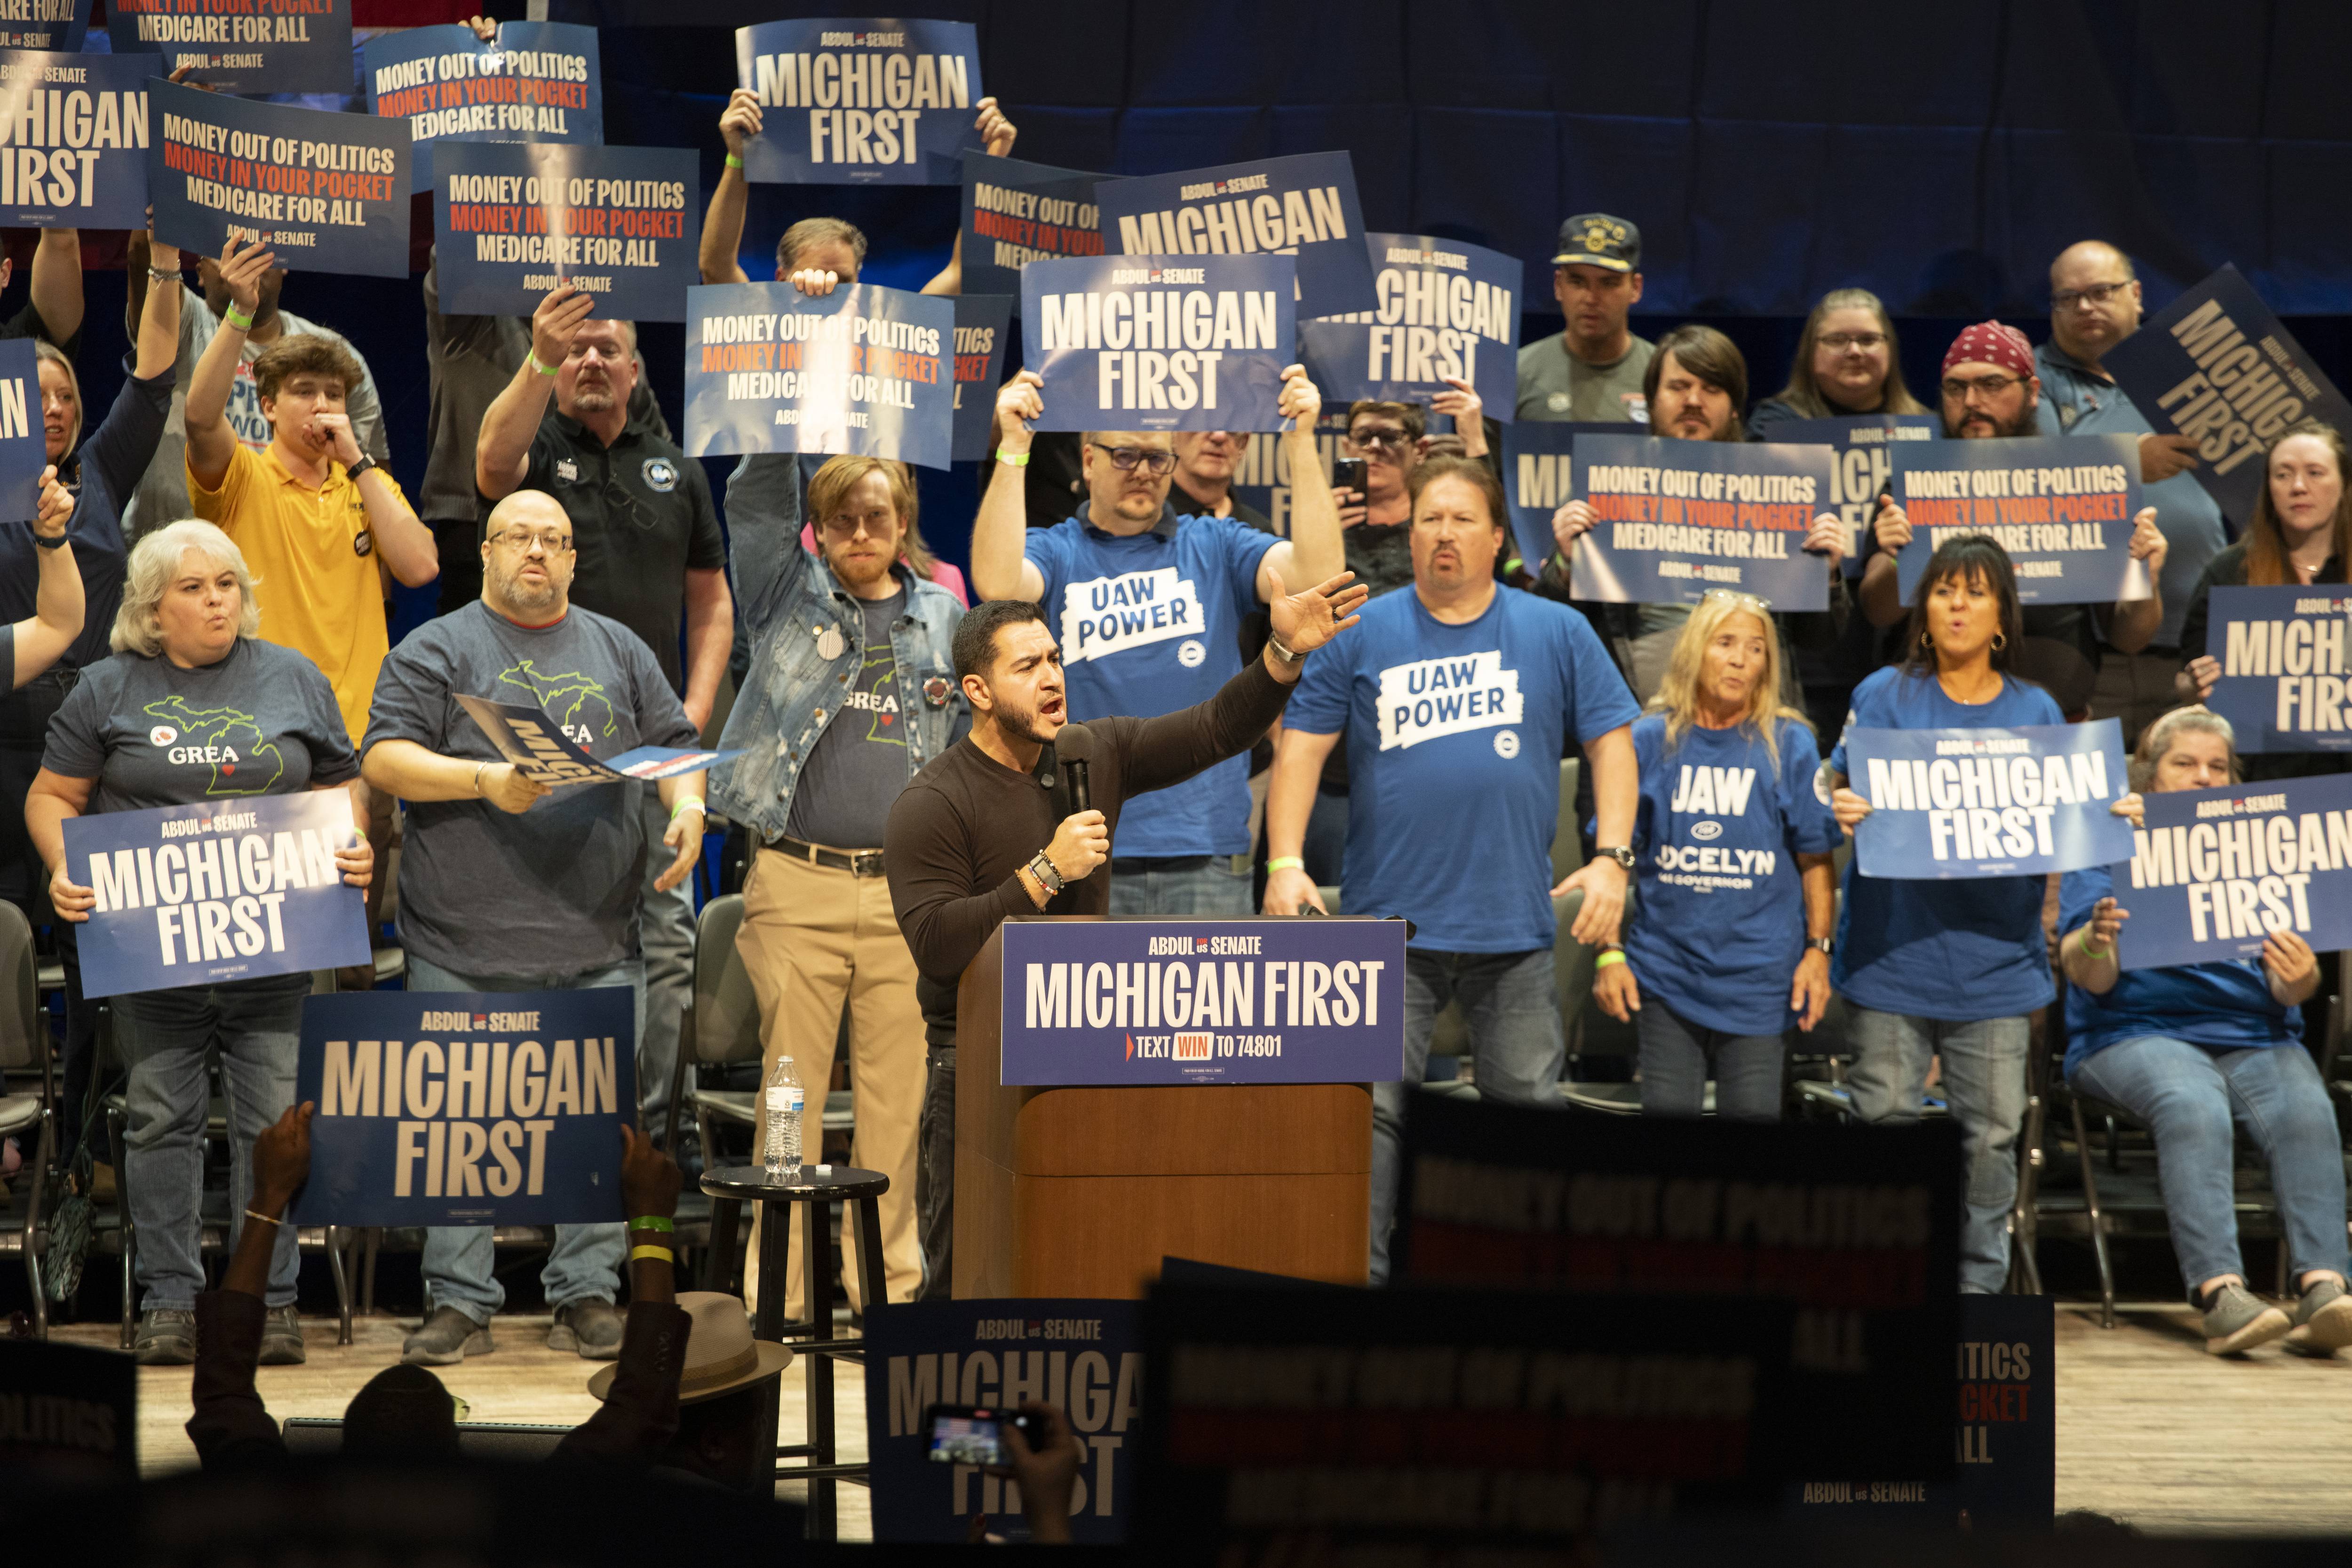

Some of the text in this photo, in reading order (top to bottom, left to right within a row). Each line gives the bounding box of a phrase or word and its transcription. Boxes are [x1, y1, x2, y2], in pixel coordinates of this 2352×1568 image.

[24, 33, 51, 48] SENATE
[138, 15, 310, 43] MEDICARE FOR ALL
[821, 32, 905, 48] ABDUL SENATE
[45, 67, 87, 83] SENATE
[176, 53, 263, 69] ABDUL SENATE
[376, 56, 436, 95] MONEY
[438, 52, 477, 81] OUT
[506, 50, 588, 82] POLITICS
[378, 77, 588, 118] MONEY IN YOUR POCKET
[756, 52, 969, 110] MICHIGAN
[498, 104, 568, 135] FOR ALL
[810, 110, 921, 165] FIRST
[164, 112, 395, 174] MONEY OUT OF POLITICS
[0, 148, 100, 208] IRST
[164, 141, 395, 201] MONEY IN YOUR POCKET
[1180, 174, 1269, 201] ABDUL SENATE
[187, 175, 366, 226] MEDICARE FOR ALL
[449, 175, 685, 210] MONEY OUT OF POLITICS
[975, 182, 1039, 220] MONEY
[1039, 197, 1077, 227] OUT
[273, 231, 317, 247] SENATE
[450, 204, 685, 239] MONEY IN POCKET
[974, 209, 1058, 252] MONEY IN
[1119, 186, 1347, 255] MICHIGAN
[477, 234, 660, 267] MEDICARE FOR ALL
[523, 274, 612, 293] ABDUL SENATE
[1112, 268, 1205, 285] ABDUL SENATE
[702, 313, 940, 356] MONEY OUT POLITICS
[1041, 291, 1277, 350] MICHIGAN
[702, 343, 777, 373] MONEY
[779, 343, 803, 370] IN
[866, 347, 939, 385] POCKET
[1368, 326, 1479, 387] FIRST
[881, 378, 915, 410] ALL
[1098, 350, 1222, 410] FIRST
[2156, 370, 2266, 476] FIRST
[1588, 465, 1661, 495] MONEY
[1661, 469, 1700, 498] OUT
[1700, 471, 1725, 501] OF
[1725, 475, 1817, 504] POLITICS
[1904, 470, 1971, 498] MONEY
[1971, 470, 2010, 497] OUT
[2011, 468, 2038, 497] OF
[2037, 465, 2128, 495] POLITICS
[1588, 494, 1816, 532] MONEY IN YOUR POCKET
[1906, 493, 2127, 526] MONEY IN YOUR POCKET
[1613, 521, 1788, 560] MEDICARE FOR ALL
[2031, 524, 2071, 552] FOR
[2071, 522, 2106, 551] ALL
[1092, 576, 1156, 612] UAW
[1078, 596, 1188, 648] POWER
[1408, 659, 1478, 695] UAW
[1394, 687, 1505, 735] POWER
[167, 745, 239, 765] GREA
[1867, 750, 2109, 811] MICHIGAN
[2196, 793, 2287, 818] ABDUL SENATE
[162, 818, 201, 839] ABDUL
[213, 812, 258, 832] SENATE
[1928, 805, 2055, 861] FIRST
[2130, 809, 2352, 889] MICHIGAN
[89, 827, 341, 913] MICHIGAN
[2187, 873, 2311, 942] FIRST
[156, 892, 285, 966] FIRST
[1149, 937, 1194, 955] ABDUL
[1196, 945, 1208, 953] US
[1210, 936, 1262, 955] SENATE
[1026, 961, 1384, 1028] MICHIGAN FIRST
[421, 1011, 540, 1033] ABDUL SENATE
[1136, 1035, 1282, 1058] TEXT WIN TO 74801
[321, 1037, 618, 1119] MICHIGAN
[394, 1119, 555, 1198] FIRST
[975, 1319, 1102, 1341] ABDUL SENATE
[888, 1350, 1146, 1437] MICHIGA
[1803, 1482, 1853, 1504] ABDUL
[1870, 1482, 1926, 1503] SENATE
